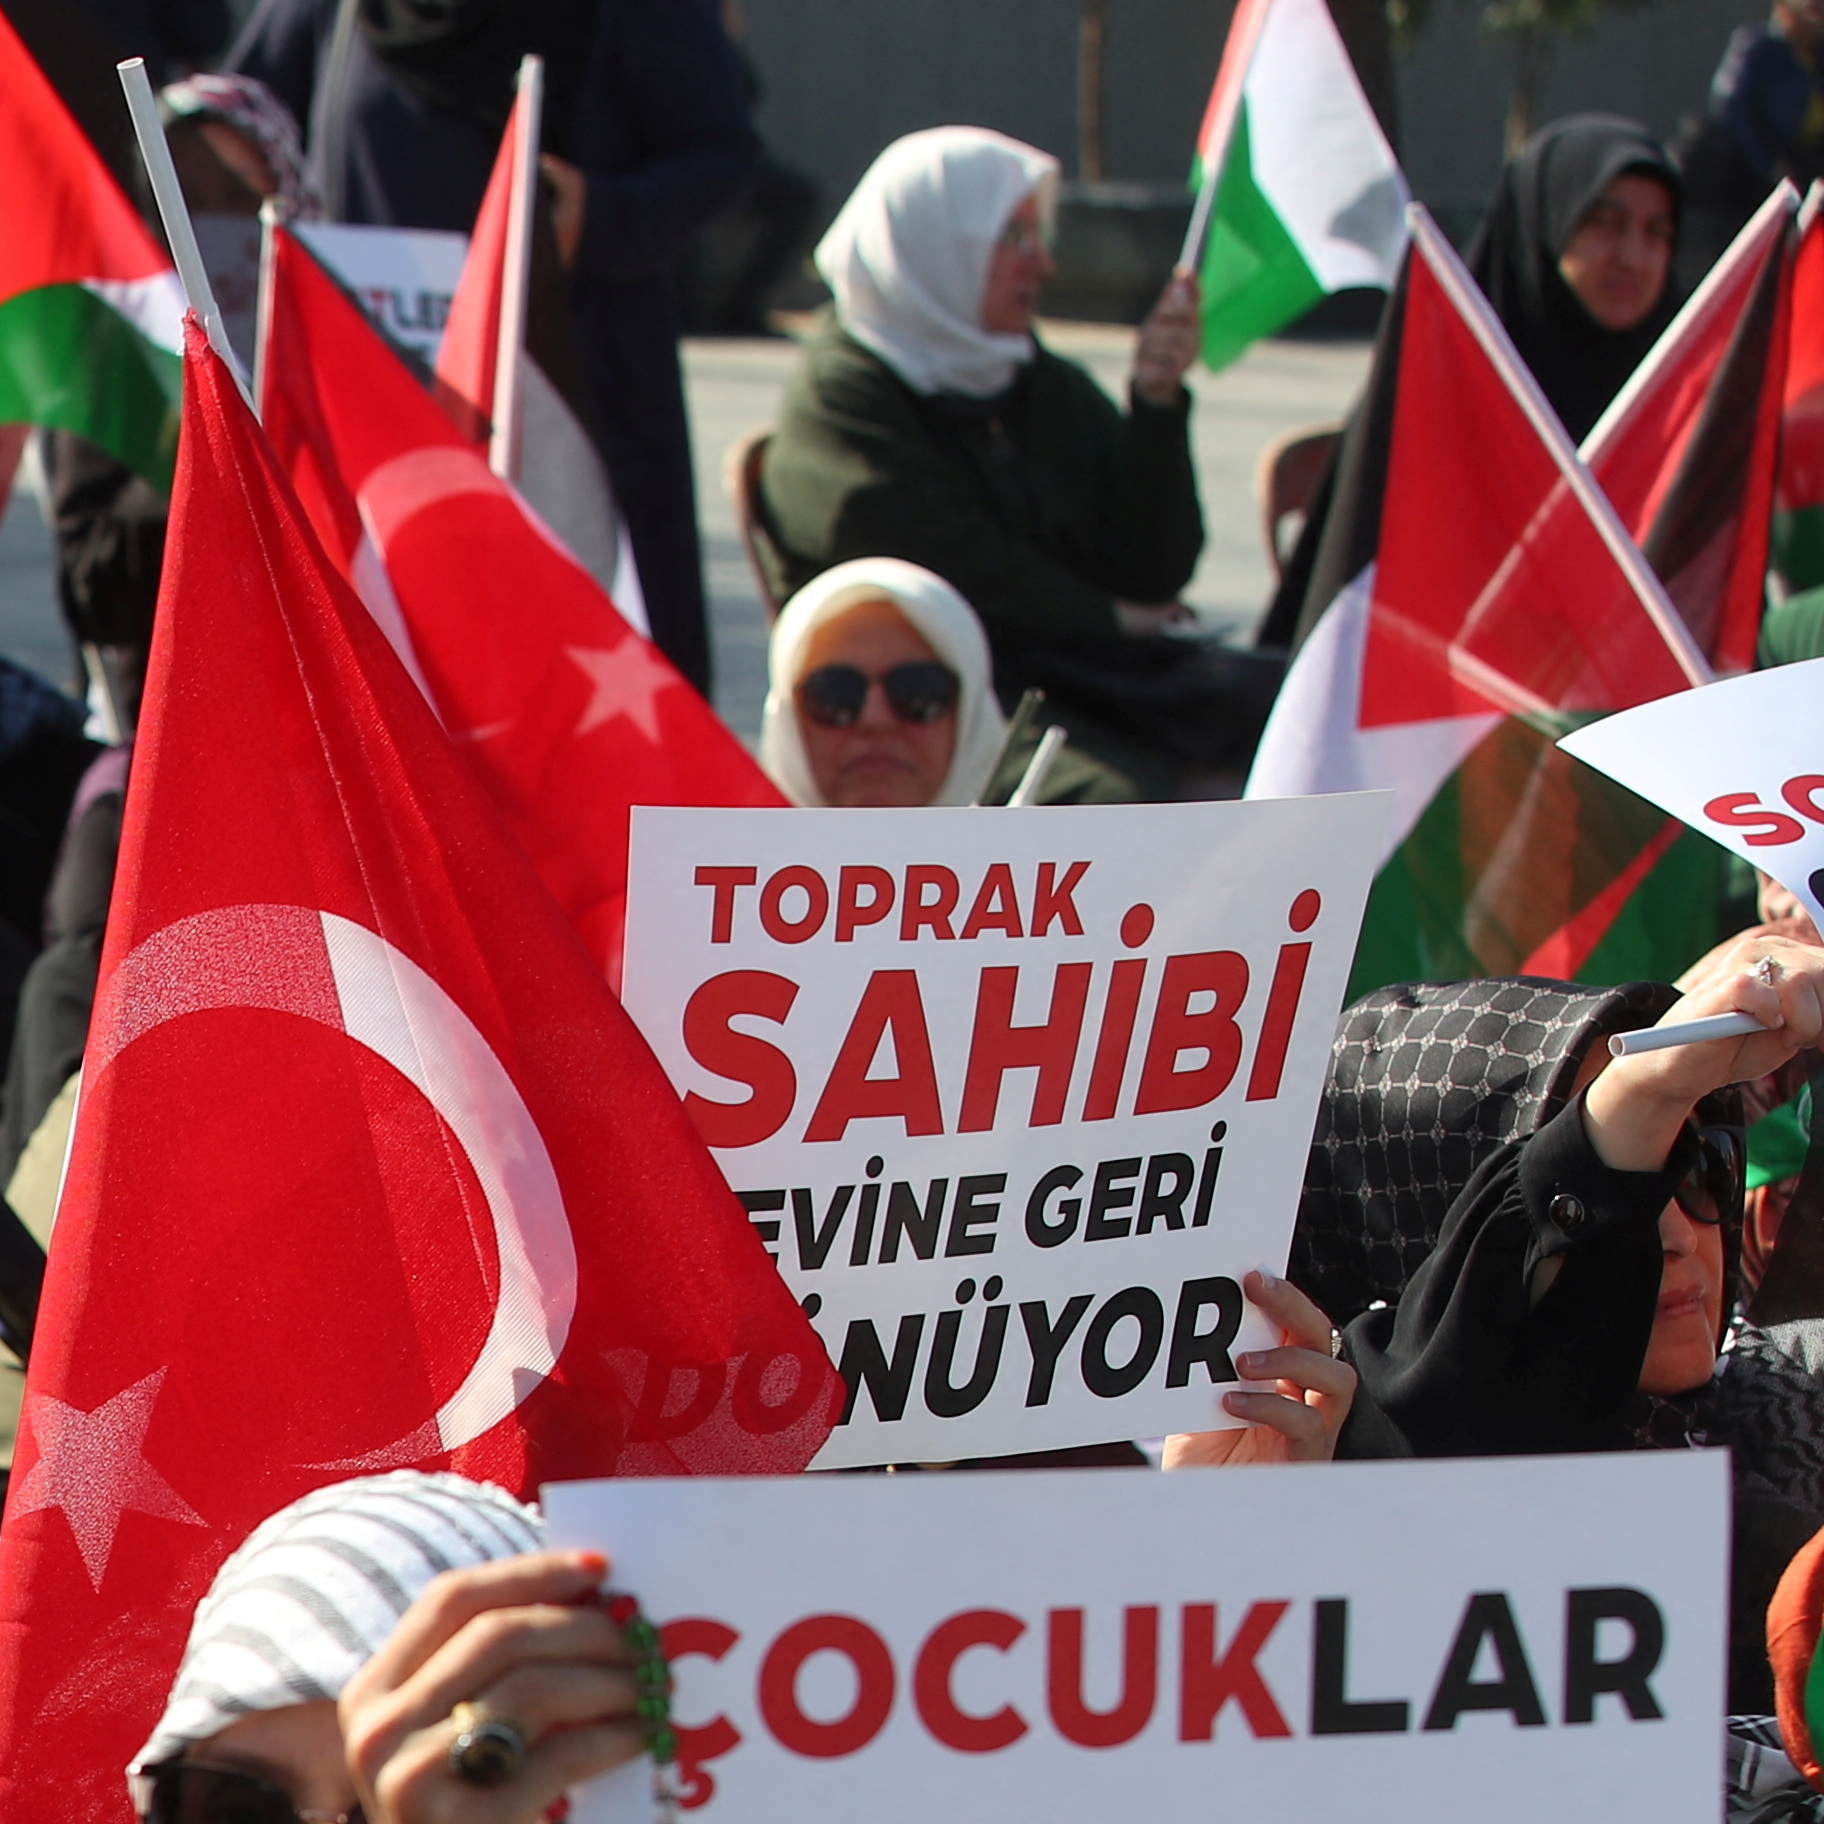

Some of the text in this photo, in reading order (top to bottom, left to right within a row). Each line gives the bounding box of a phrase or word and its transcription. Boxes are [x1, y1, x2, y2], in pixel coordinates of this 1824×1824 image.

[694, 861, 1091, 944] TOPRAK
[682, 889, 1321, 1148] SAHİBİ
[1025, 1121, 1227, 1248] GERİ
[656, 1587, 1665, 1808] ÇOCUKLAR
